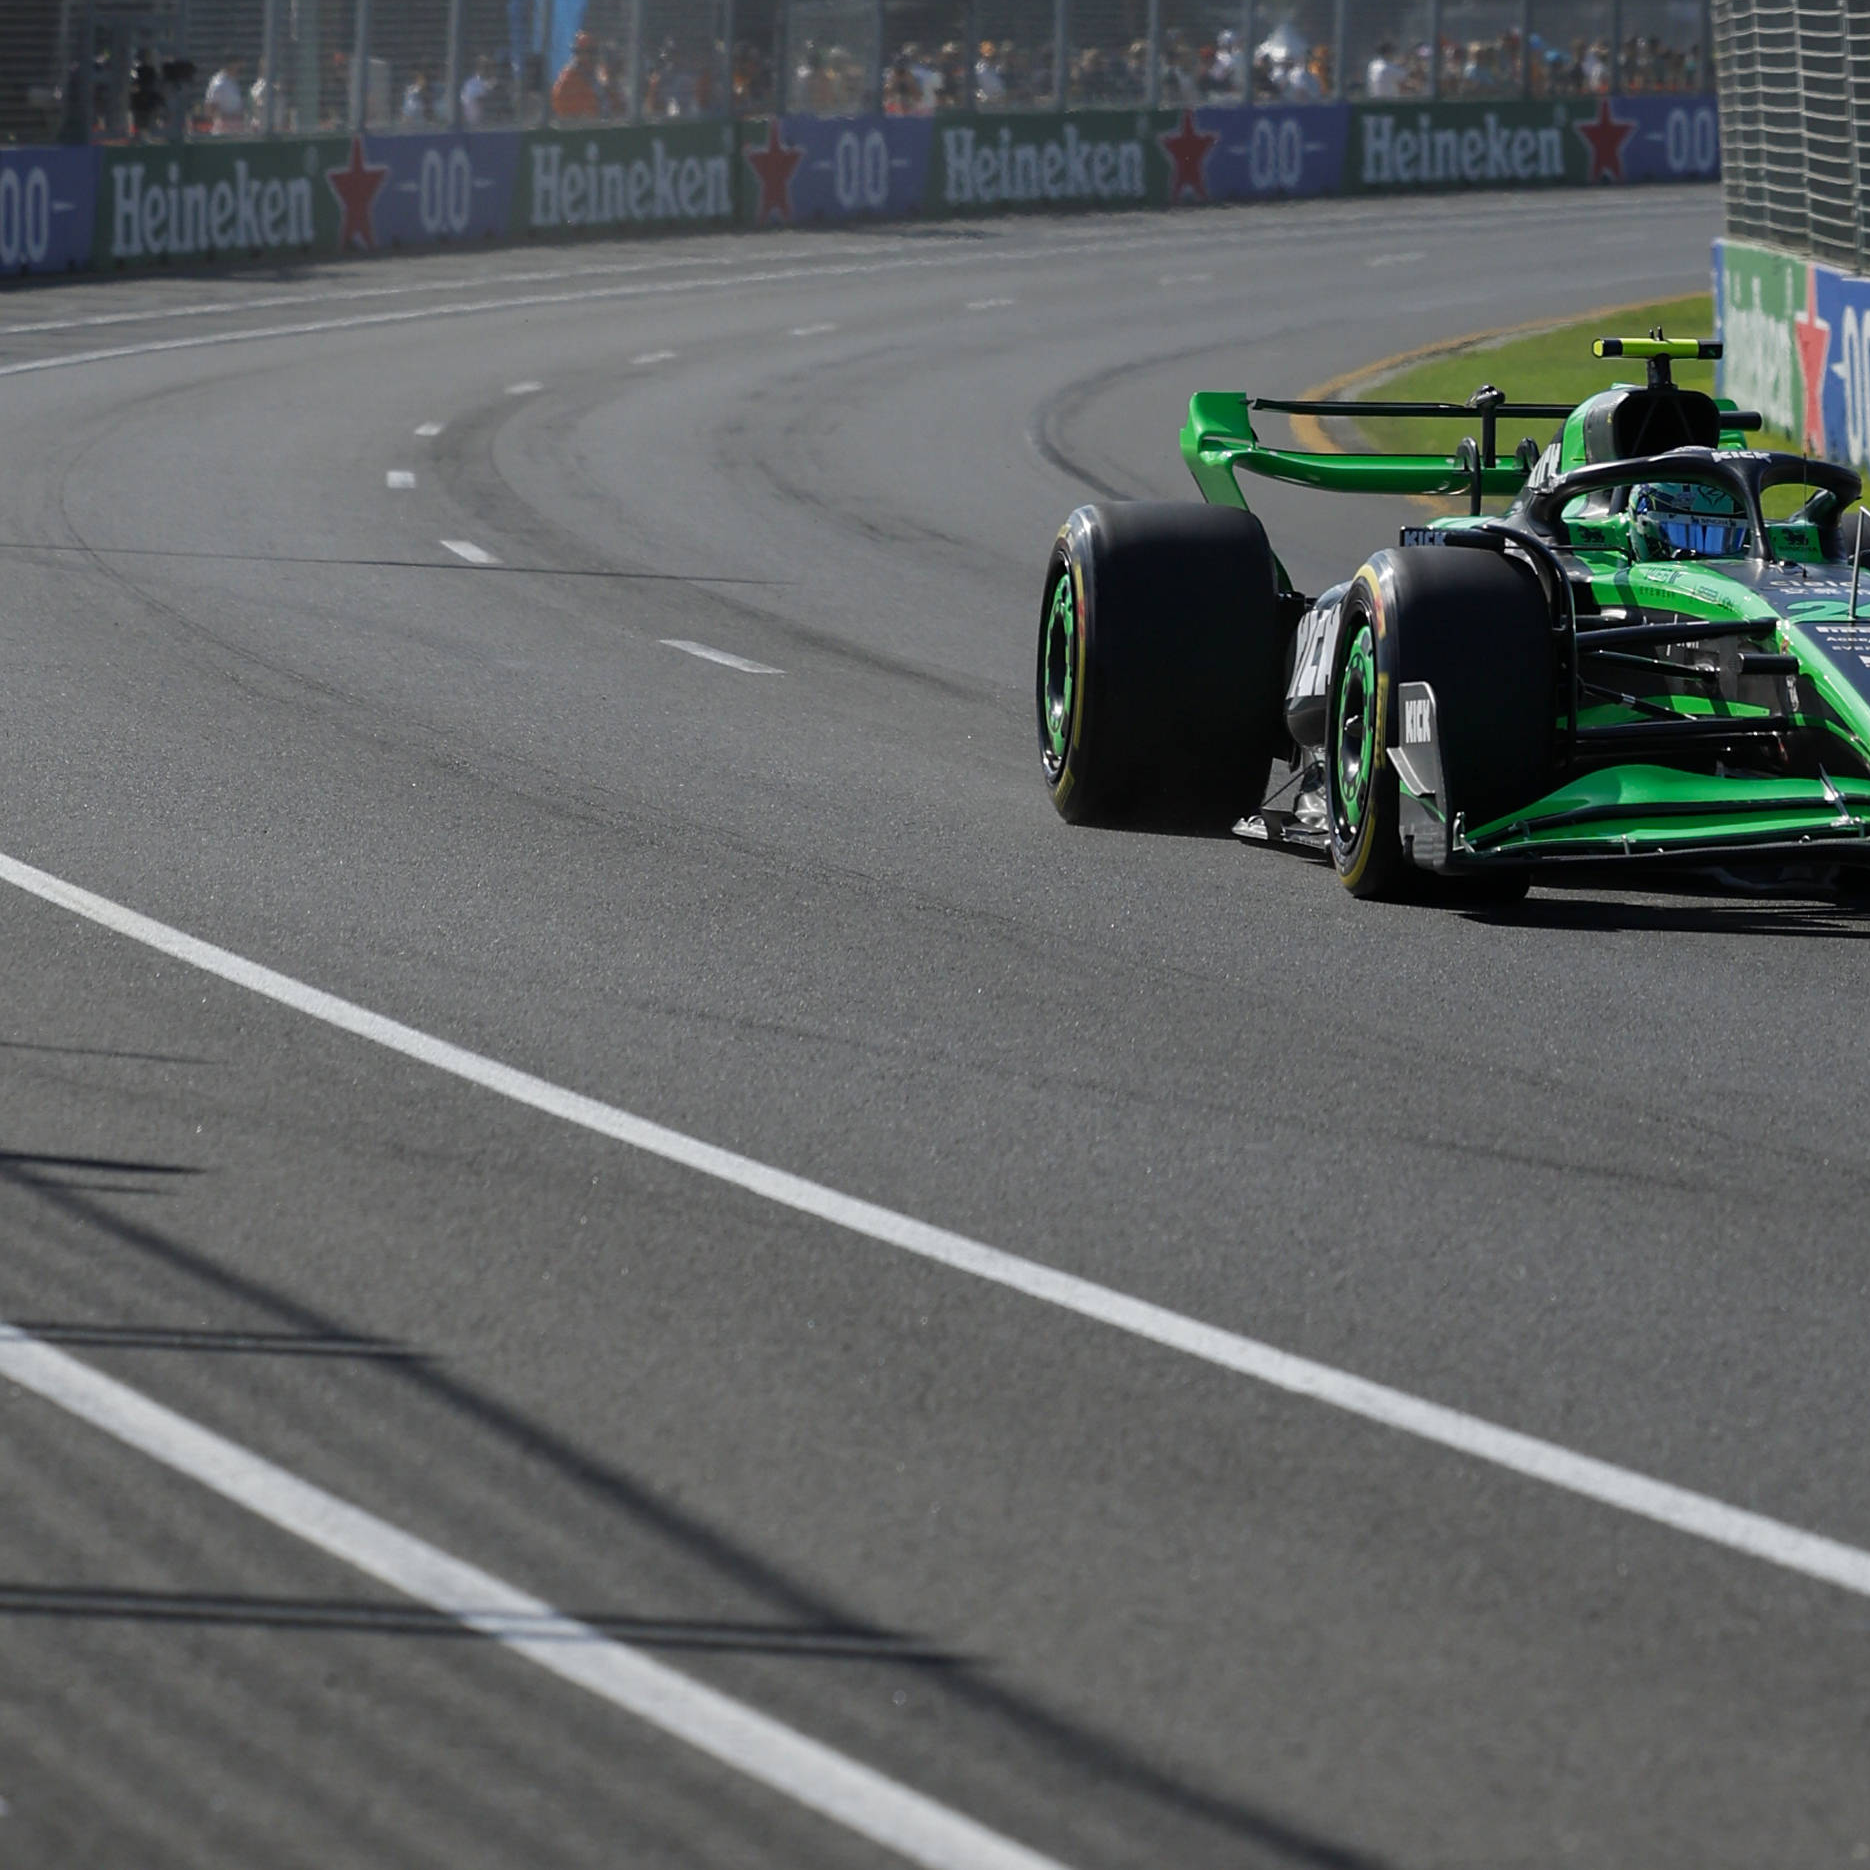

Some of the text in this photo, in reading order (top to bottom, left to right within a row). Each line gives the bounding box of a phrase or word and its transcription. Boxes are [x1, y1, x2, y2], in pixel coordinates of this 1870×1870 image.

[529, 137, 733, 227] Heineken
[942, 122, 1147, 204] Heineken
[1361, 112, 1564, 185] Heineken
[110, 160, 314, 257] Heineken
[1711, 450, 1772, 463] KICK
[1404, 531, 1447, 547] KICK
[1405, 699, 1431, 744] KICK
